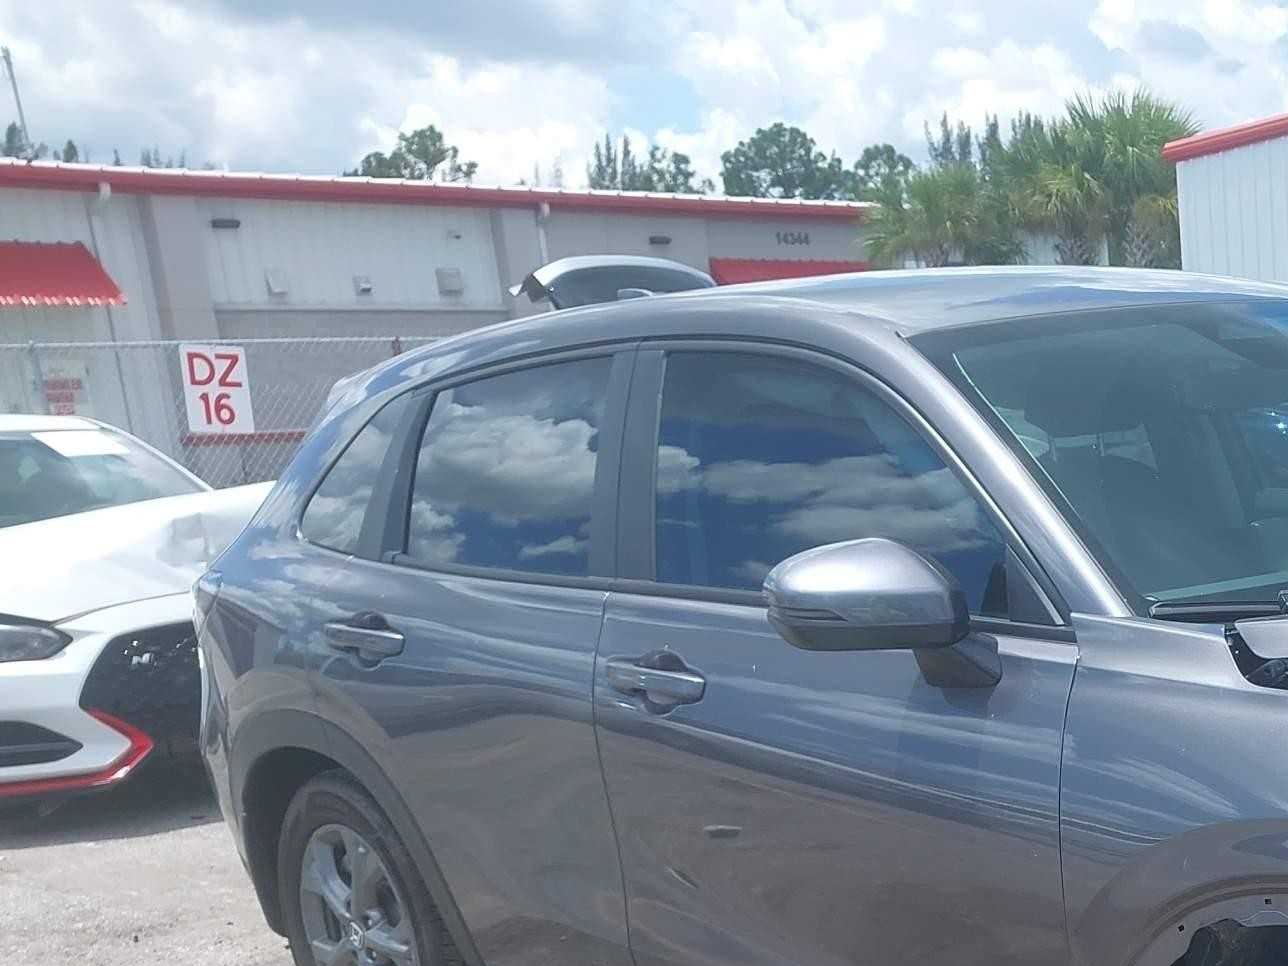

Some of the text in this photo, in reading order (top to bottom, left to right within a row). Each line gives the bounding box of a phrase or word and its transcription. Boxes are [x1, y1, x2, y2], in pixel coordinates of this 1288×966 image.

[776, 232, 809, 246] 14344
[187, 352, 243, 388] DZ
[199, 392, 236, 425] 16
